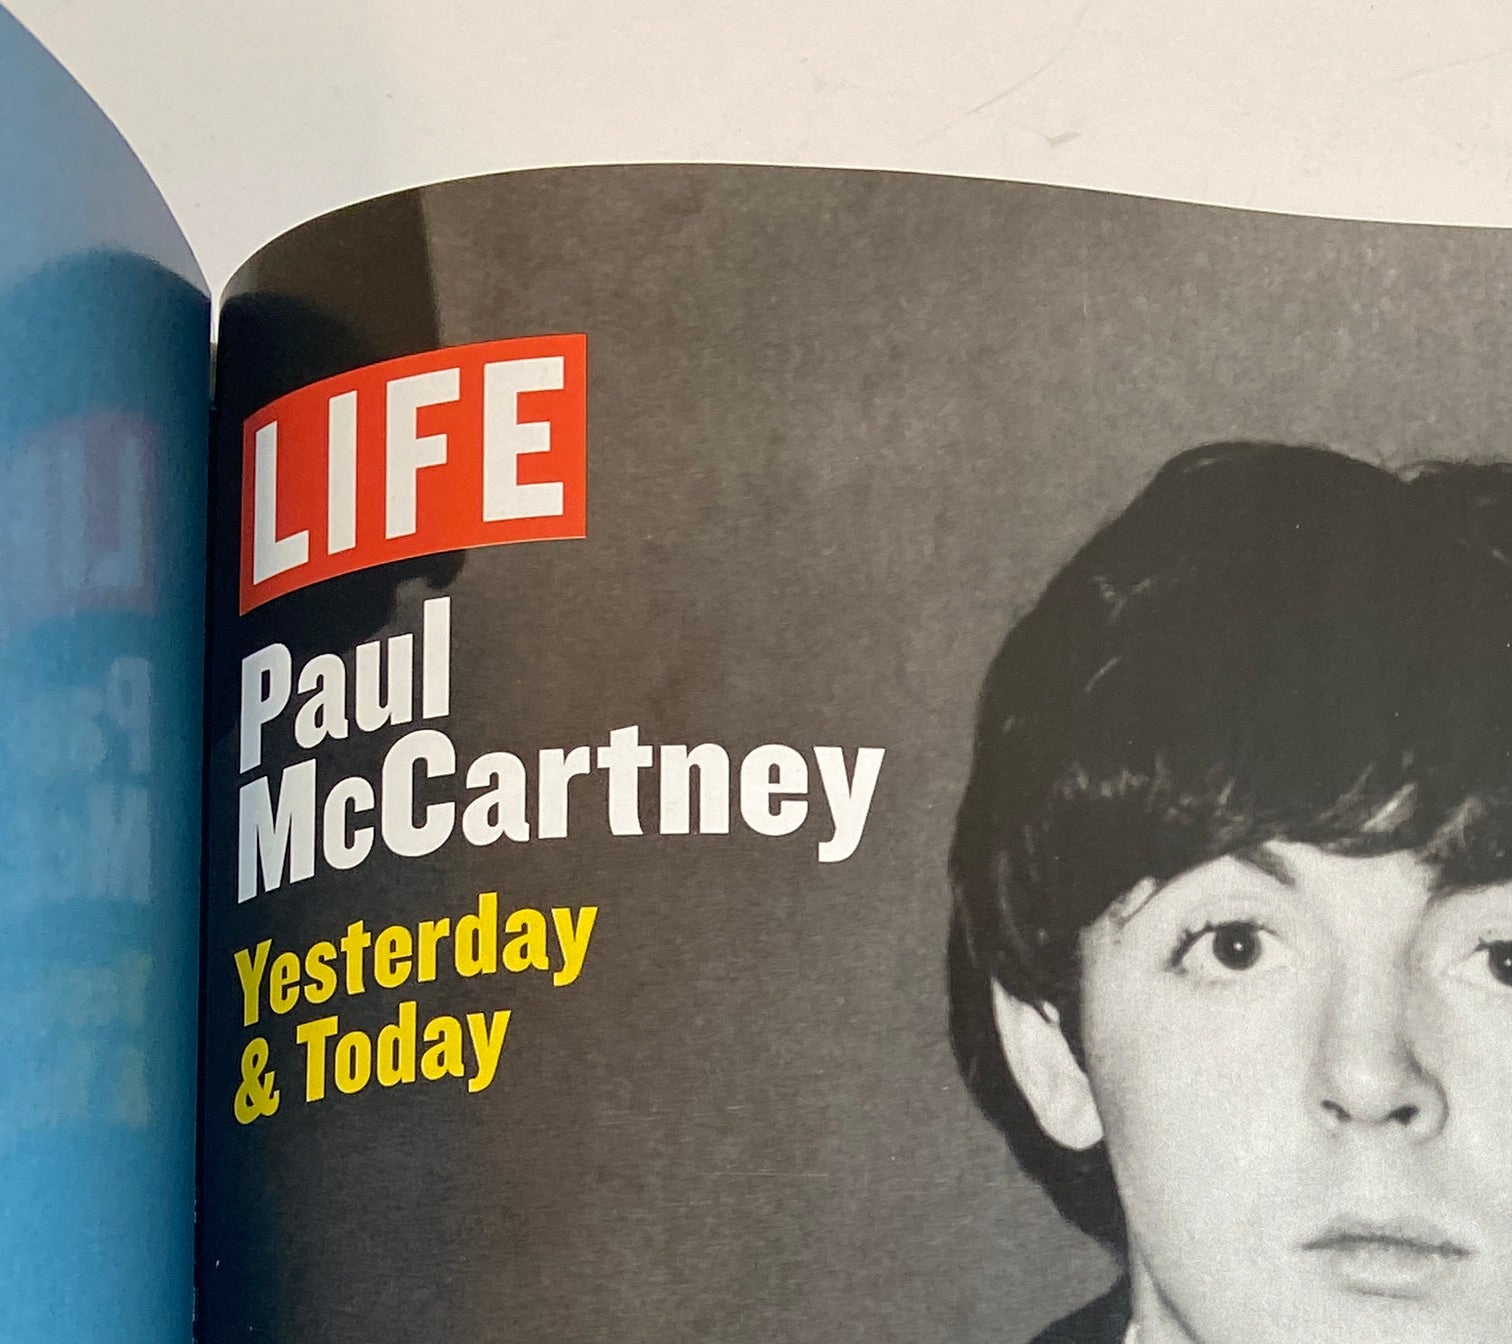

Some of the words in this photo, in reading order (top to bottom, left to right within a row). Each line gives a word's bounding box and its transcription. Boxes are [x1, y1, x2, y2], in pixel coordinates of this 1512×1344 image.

[252, 356, 565, 586] LIFE
[239, 597, 451, 773] Paul
[238, 727, 886, 904] McCartney
[235, 893, 598, 1027] Yesterday
[235, 1038, 281, 1124] &
[298, 1003, 512, 1102] Today
